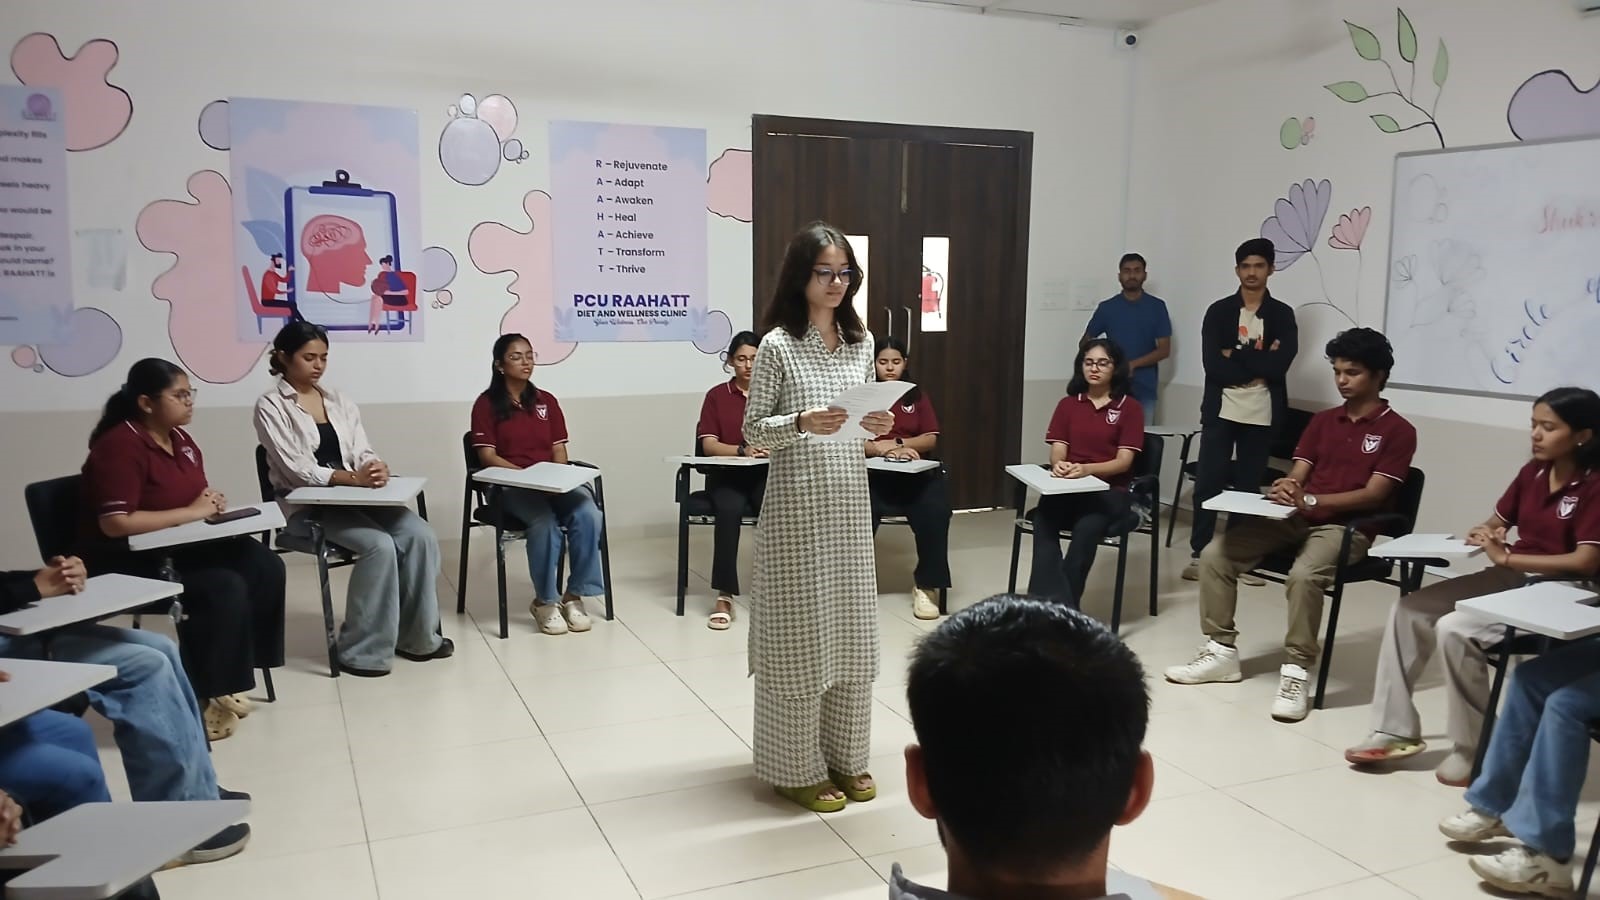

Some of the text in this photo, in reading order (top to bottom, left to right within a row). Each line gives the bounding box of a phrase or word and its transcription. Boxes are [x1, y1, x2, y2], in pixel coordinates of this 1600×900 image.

[595, 159, 602, 168] R
[613, 160, 668, 172] Rejuvenate
[596, 177, 603, 186] A
[614, 178, 645, 189] Adapt
[597, 194, 604, 203] A
[615, 195, 654, 205] Awaken
[597, 212, 604, 221] H
[614, 213, 637, 222] Heal
[597, 230, 604, 239] A
[615, 230, 654, 240] Achieve
[598, 247, 604, 256] T
[615, 248, 665, 257] Transform
[598, 264, 604, 273] T
[616, 265, 646, 274] Thrive
[573, 294, 690, 308] PCU RAAHATT
[577, 310, 688, 318] DIET AND WELLNESS CLINIC
